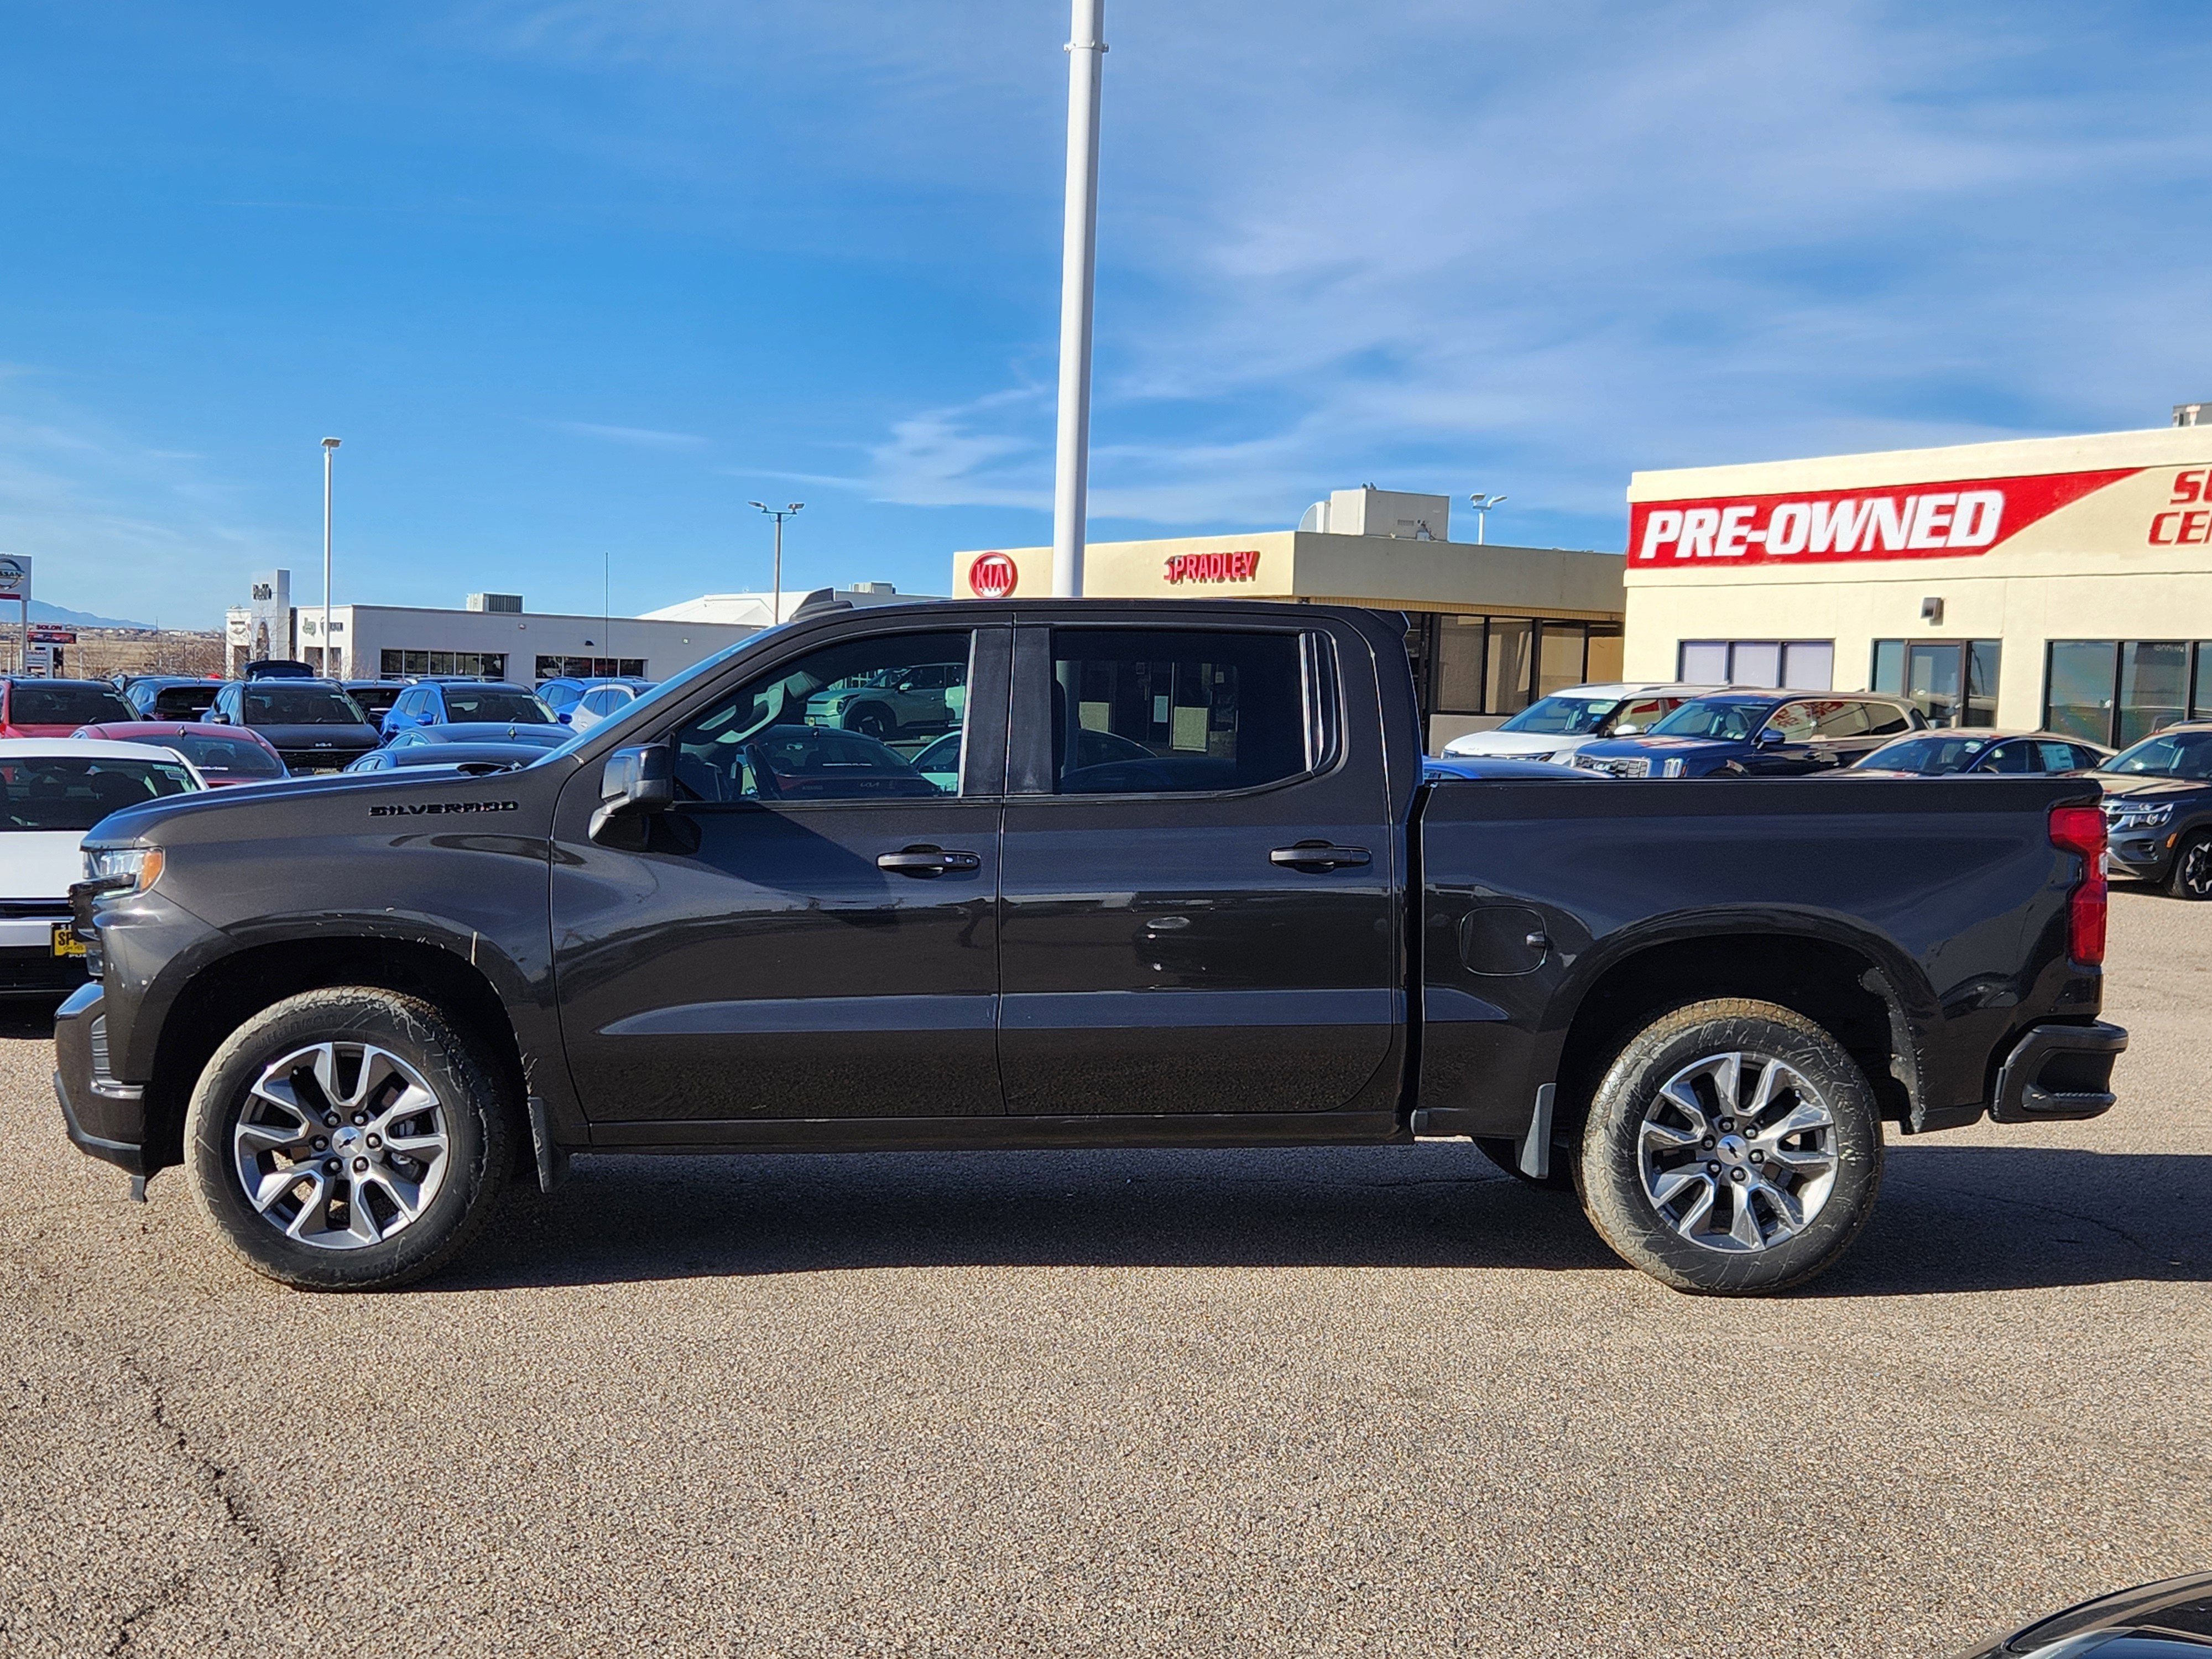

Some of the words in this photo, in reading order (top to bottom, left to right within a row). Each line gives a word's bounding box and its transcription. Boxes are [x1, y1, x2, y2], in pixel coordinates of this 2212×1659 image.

[2170, 470, 2212, 505] S
[1639, 489, 2003, 560] PRE-OWNED
[976, 564, 1005, 589] KIA
[1164, 552, 1258, 582] SPRADLEY
[369, 801, 519, 817] SILVERADO
